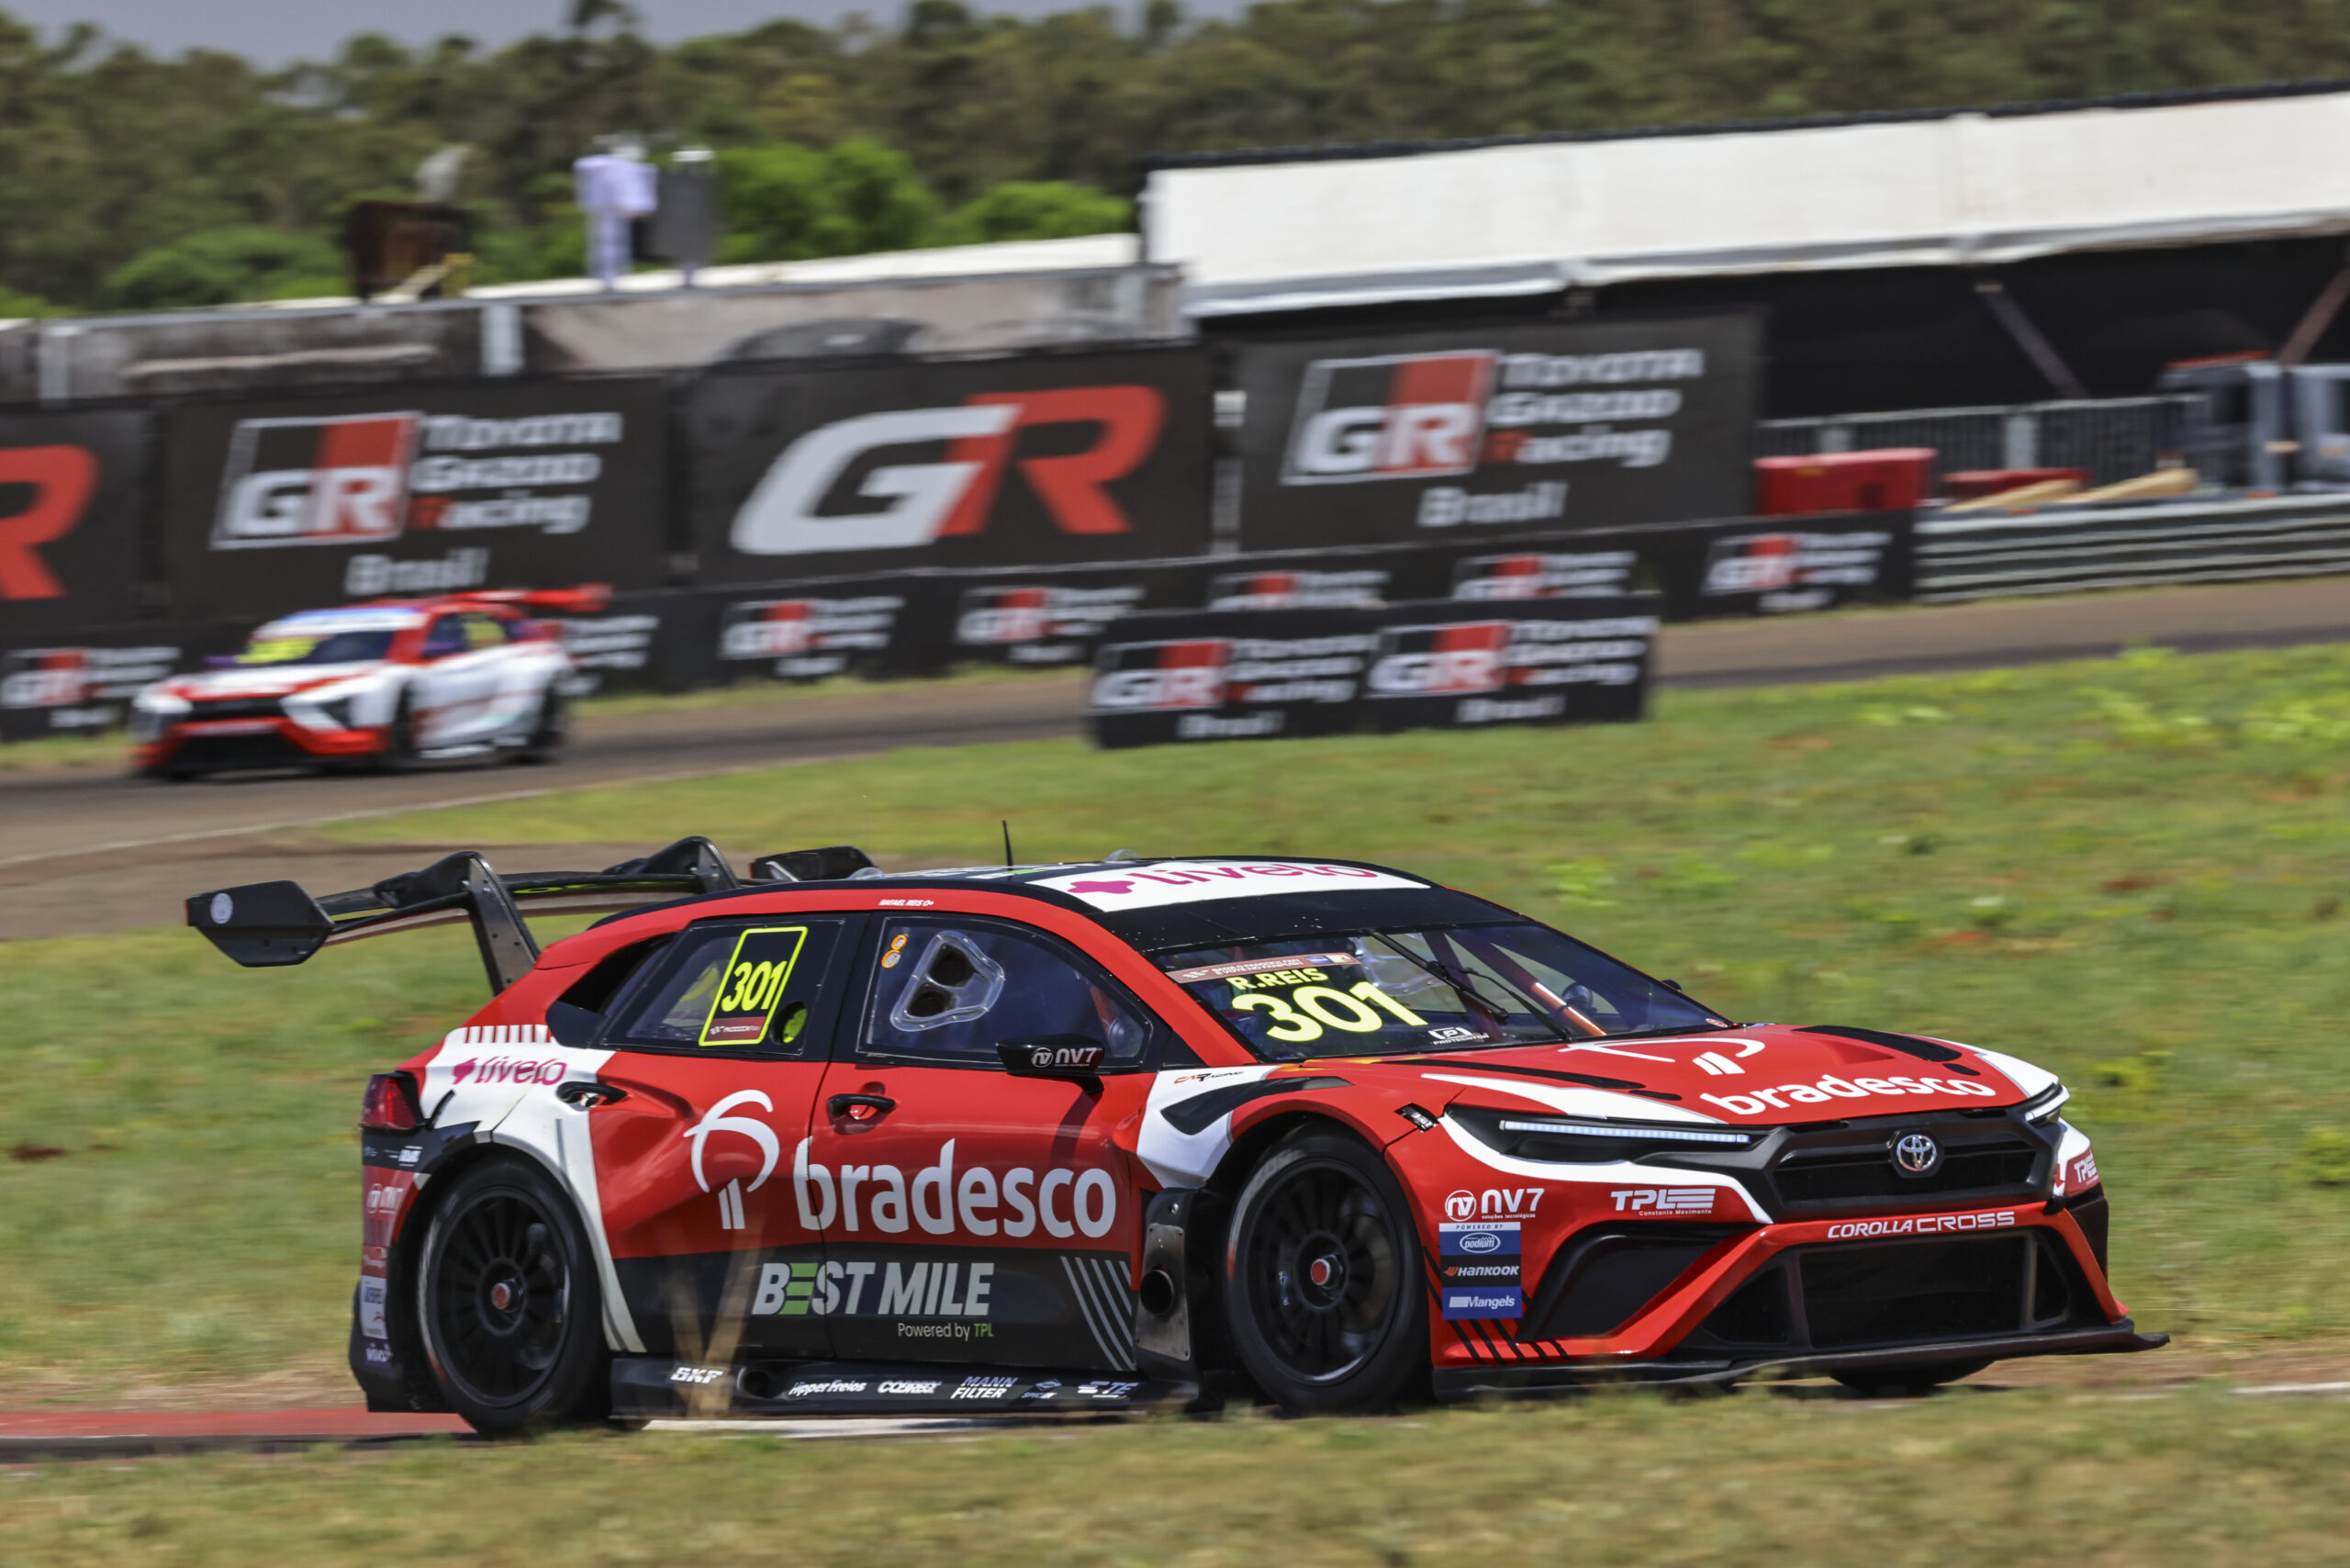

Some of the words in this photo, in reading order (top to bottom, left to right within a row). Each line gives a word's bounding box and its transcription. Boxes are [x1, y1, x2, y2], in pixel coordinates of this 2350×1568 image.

[1293, 403, 1479, 475] GR
[731, 383, 1167, 554] GR
[223, 466, 402, 539] GR
[1126, 864, 1378, 885] livelo
[722, 960, 788, 1012] 301
[1225, 968, 1329, 991] R.REIS
[1231, 980, 1428, 1042] 301
[474, 1056, 567, 1085] livelo
[1699, 1074, 1997, 1115] bradesco
[793, 1137, 1116, 1238] bradesco
[1828, 1219, 1914, 1238] COROLLA
[1917, 1211, 2015, 1233] CROSS
[1464, 1238, 1495, 1249] podium
[751, 1260, 877, 1316] BEST
[878, 1261, 995, 1316] MILE
[1468, 1295, 1516, 1310] Mangels
[898, 1322, 952, 1337] Powered
[955, 1322, 970, 1342] by
[973, 1323, 994, 1337] TPL
[670, 1366, 724, 1383] SKF
[961, 1376, 1019, 1387] MANN
[950, 1387, 1007, 1399] FILTER
